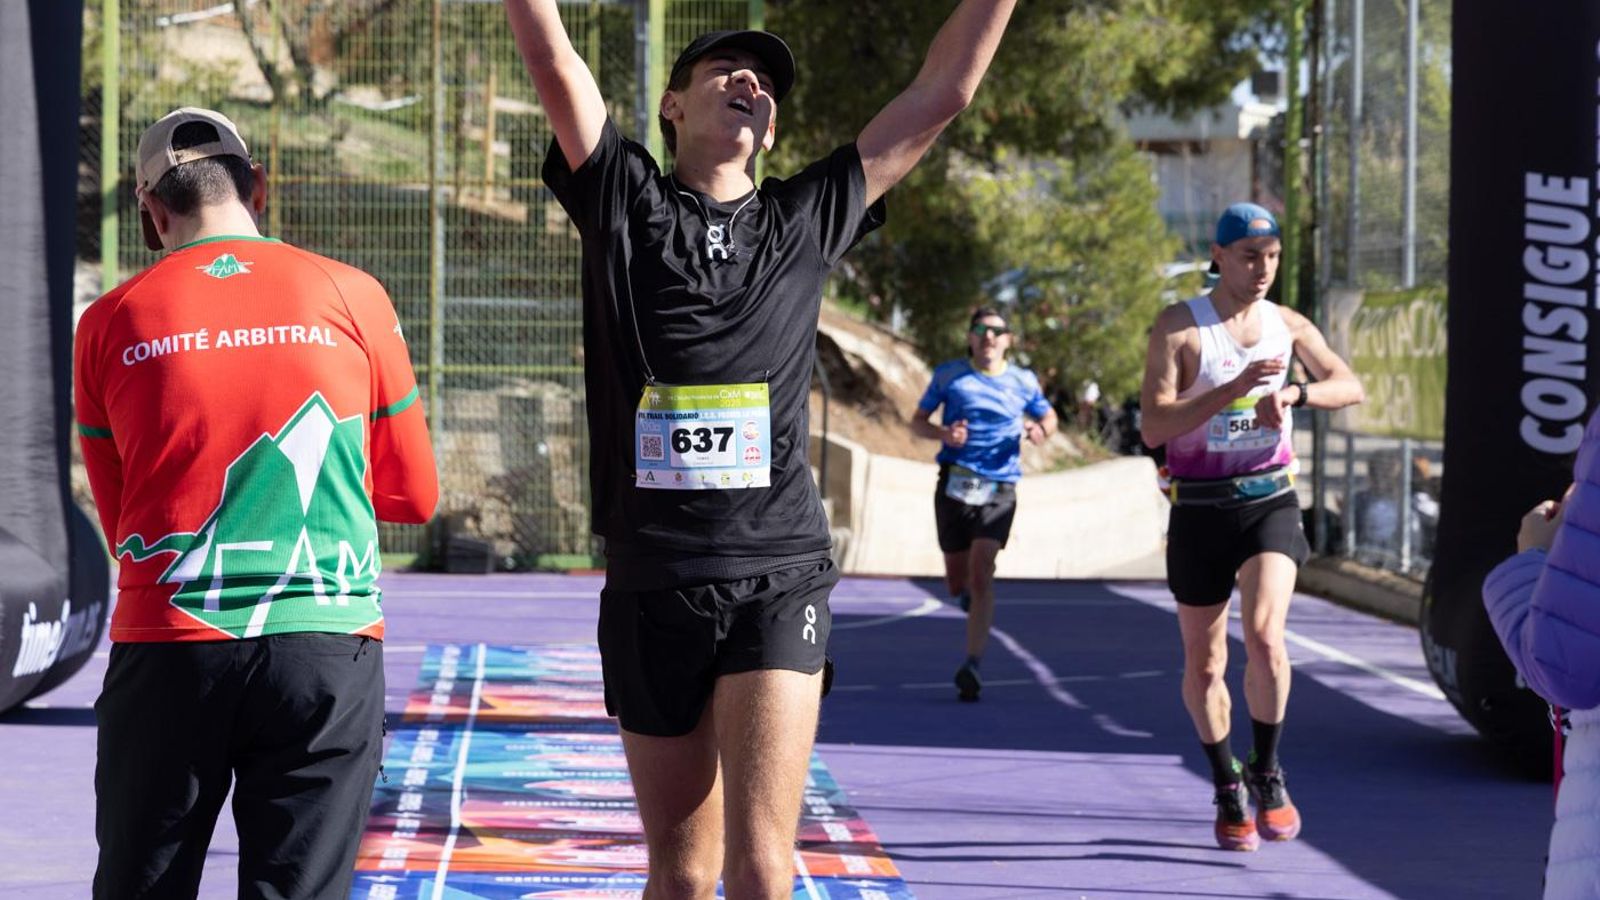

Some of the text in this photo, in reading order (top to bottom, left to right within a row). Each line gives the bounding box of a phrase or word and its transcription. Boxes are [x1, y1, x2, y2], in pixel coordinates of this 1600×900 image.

[1519, 171, 1591, 455] CONSIGUE
[122, 325, 337, 366] COMITÉ ARBITRAL
[671, 427, 734, 454] 637
